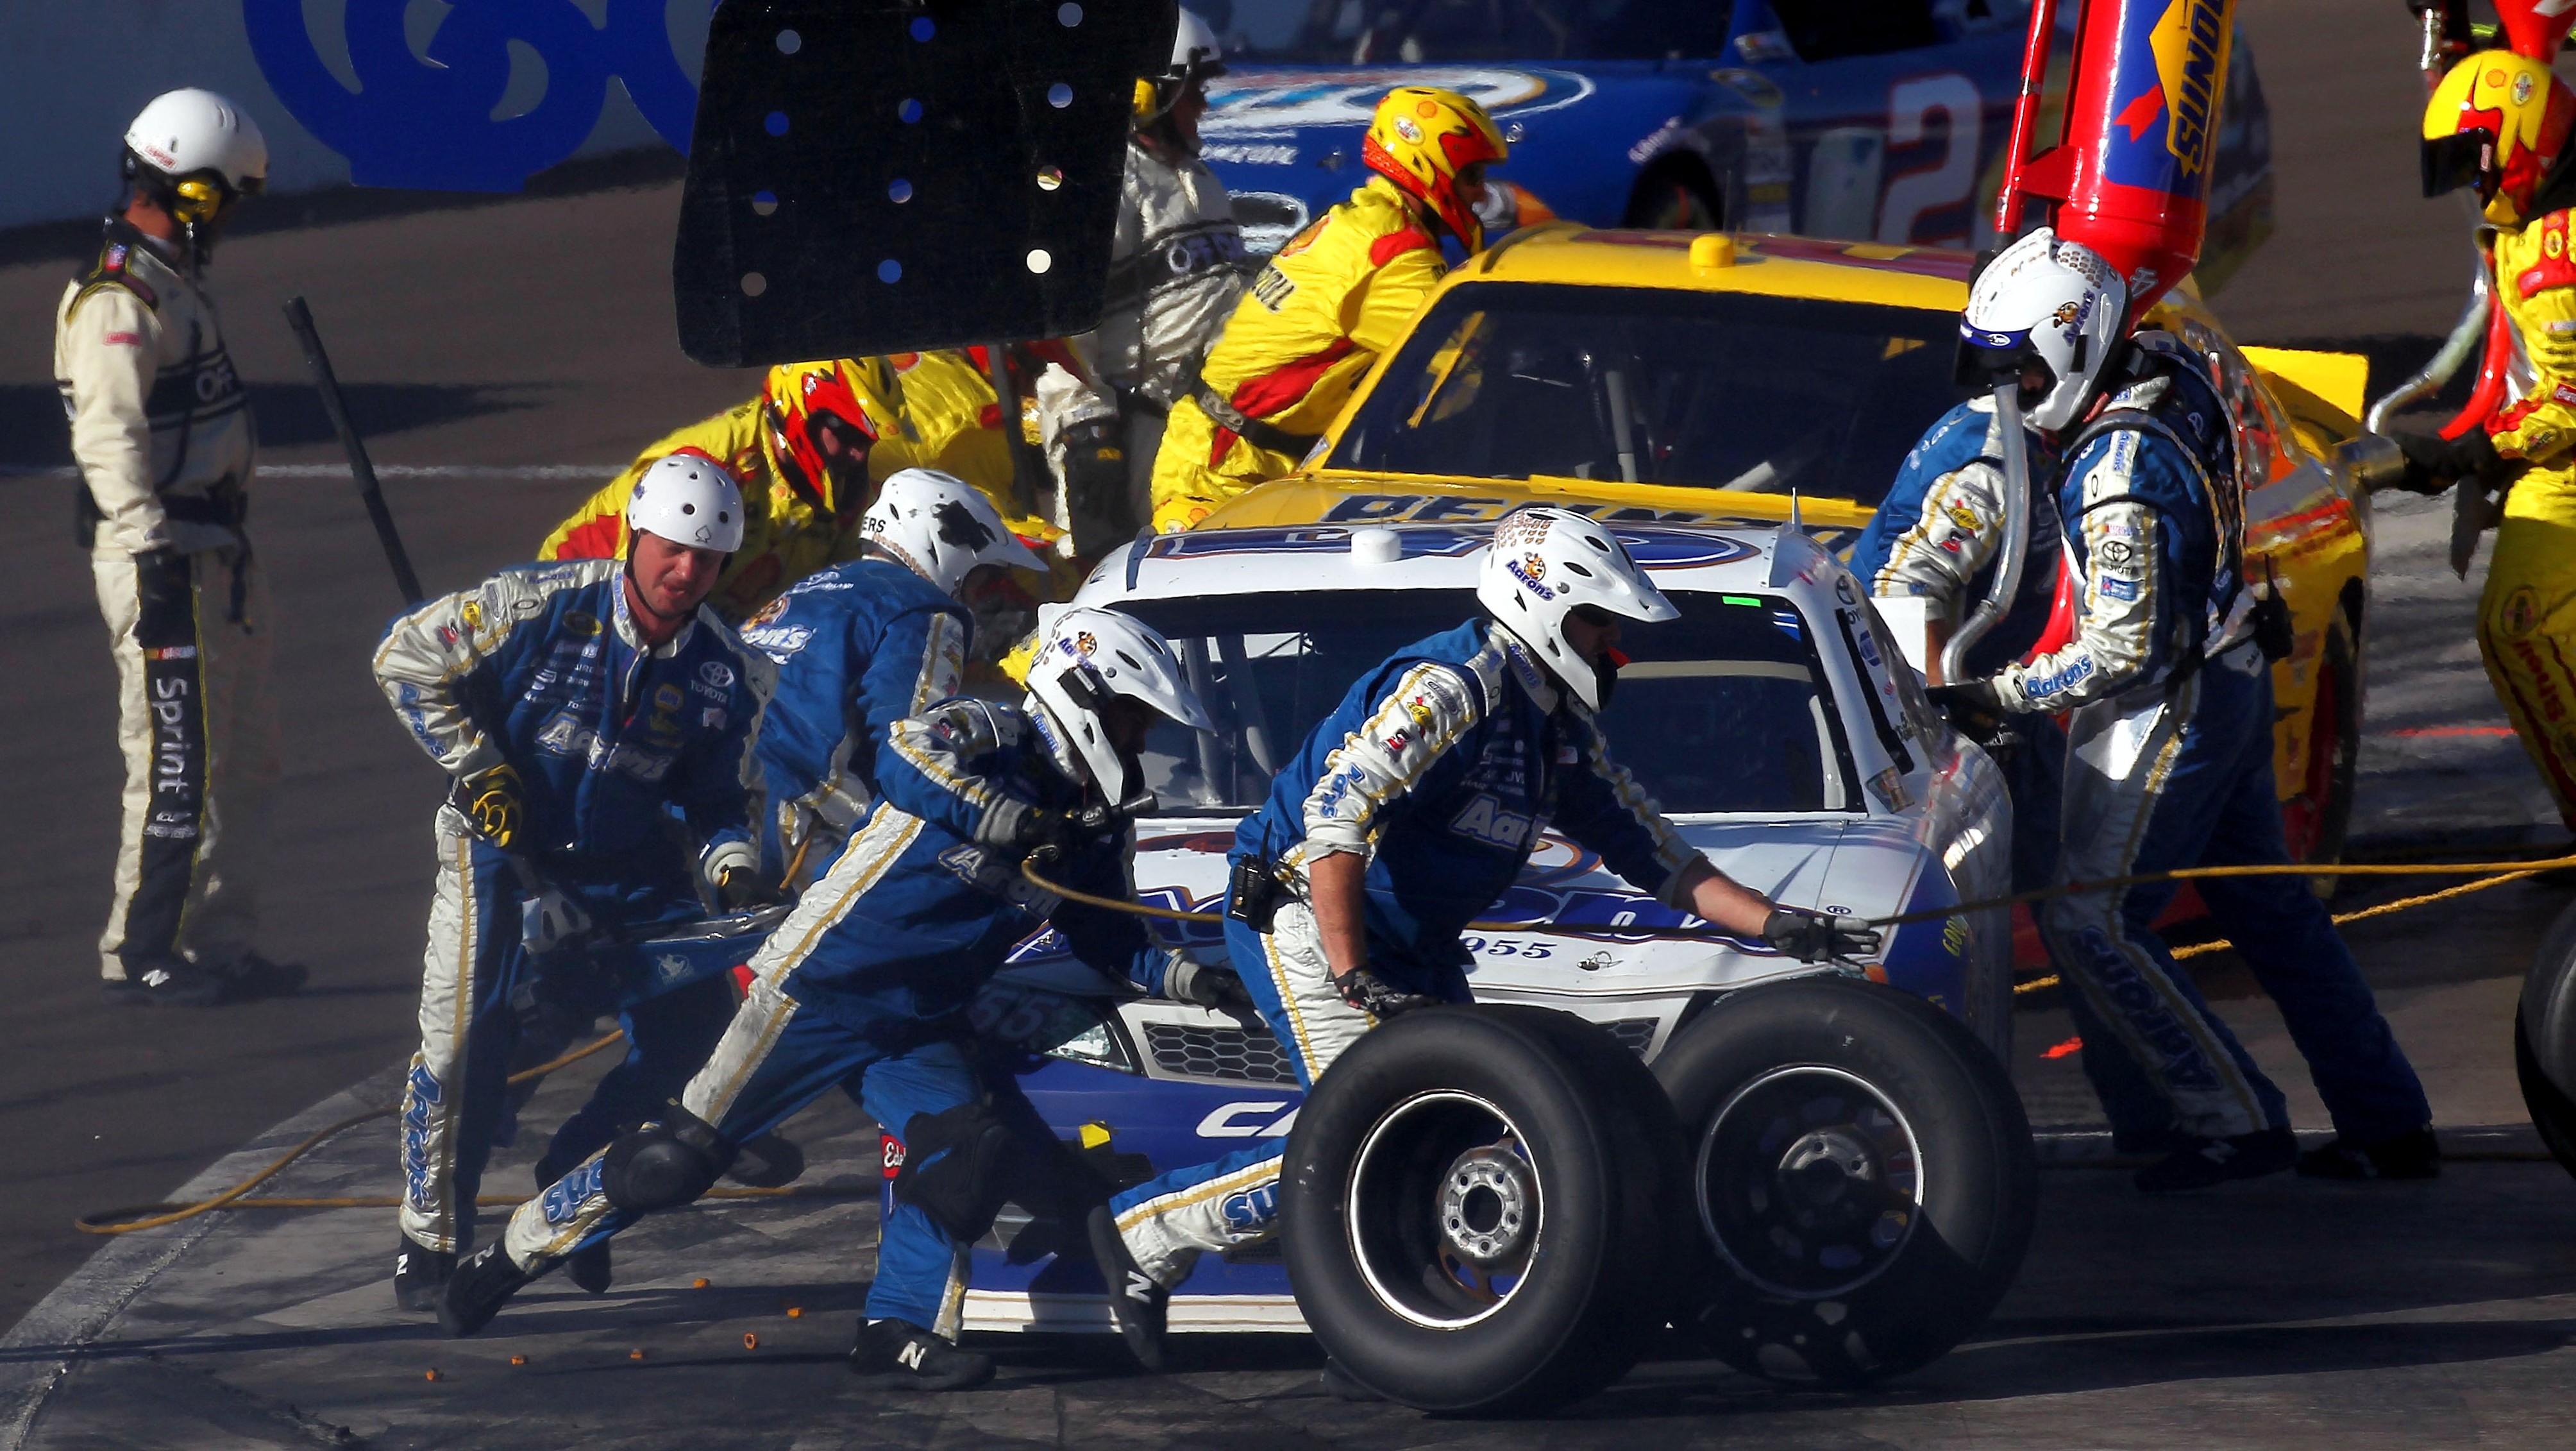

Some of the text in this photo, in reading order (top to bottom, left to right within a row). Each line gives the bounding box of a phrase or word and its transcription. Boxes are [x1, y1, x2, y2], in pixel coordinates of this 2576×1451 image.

[2171, 0, 2230, 170] SUNO
[1506, 558, 1556, 602] Aaron's
[2025, 653, 2094, 700] Aaron's
[151, 677, 189, 794] Sprint
